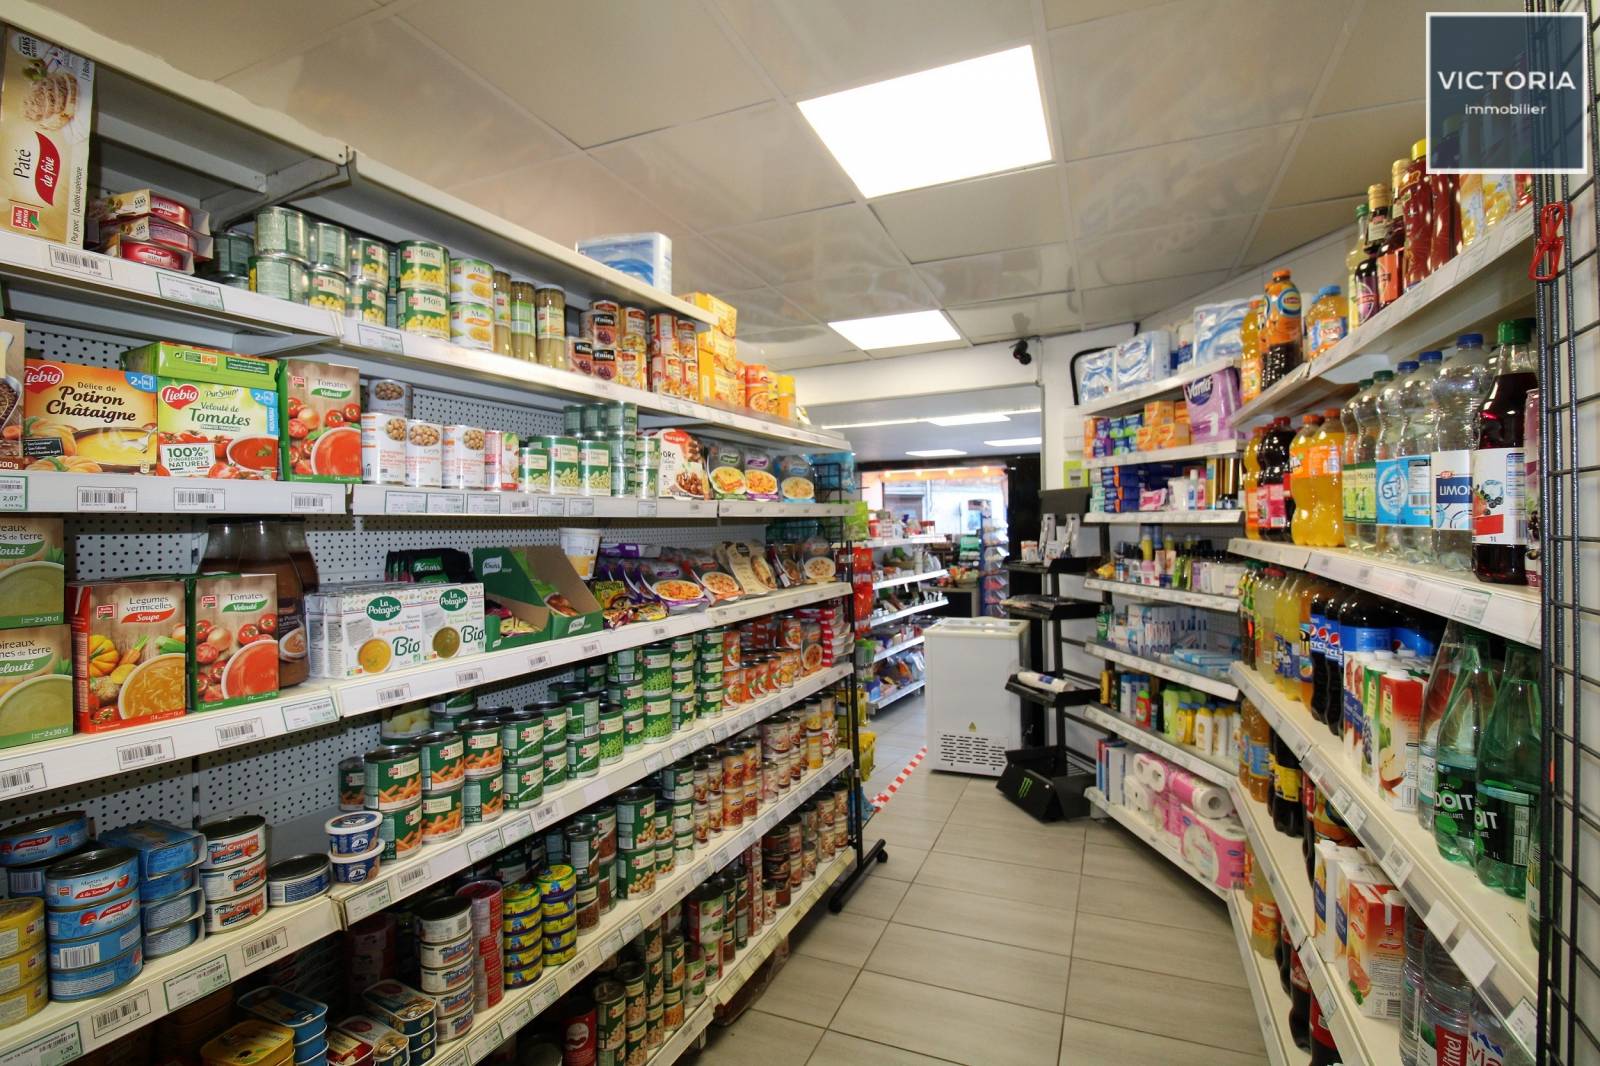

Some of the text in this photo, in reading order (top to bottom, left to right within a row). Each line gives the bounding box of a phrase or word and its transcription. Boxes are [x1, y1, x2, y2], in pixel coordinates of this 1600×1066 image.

[22, 36, 31, 56] SANS
[13, 149, 31, 178] Pâté
[40, 156, 57, 188] de foie
[77, 381, 117, 392] Délice de
[317, 378, 348, 389] Tomates
[59, 385, 125, 406] Potiron
[165, 388, 198, 403] Liebig
[46, 399, 136, 423] Châtaigne
[201, 401, 228, 412] Velouté
[189, 407, 251, 427] Tomates
[167, 447, 203, 458] 100%
[168, 460, 210, 469] NATURELS
[129, 596, 169, 606] Légumes
[229, 593, 263, 601] Tomates
[380, 599, 389, 607] La
[440, 595, 467, 609] Potagère
[126, 603, 173, 613] vermicelles
[368, 603, 401, 618] Potagère
[136, 613, 160, 623] Soupe
[460, 624, 484, 643] Bio
[28, 647, 51, 655] terre
[392, 635, 421, 656] Bio
